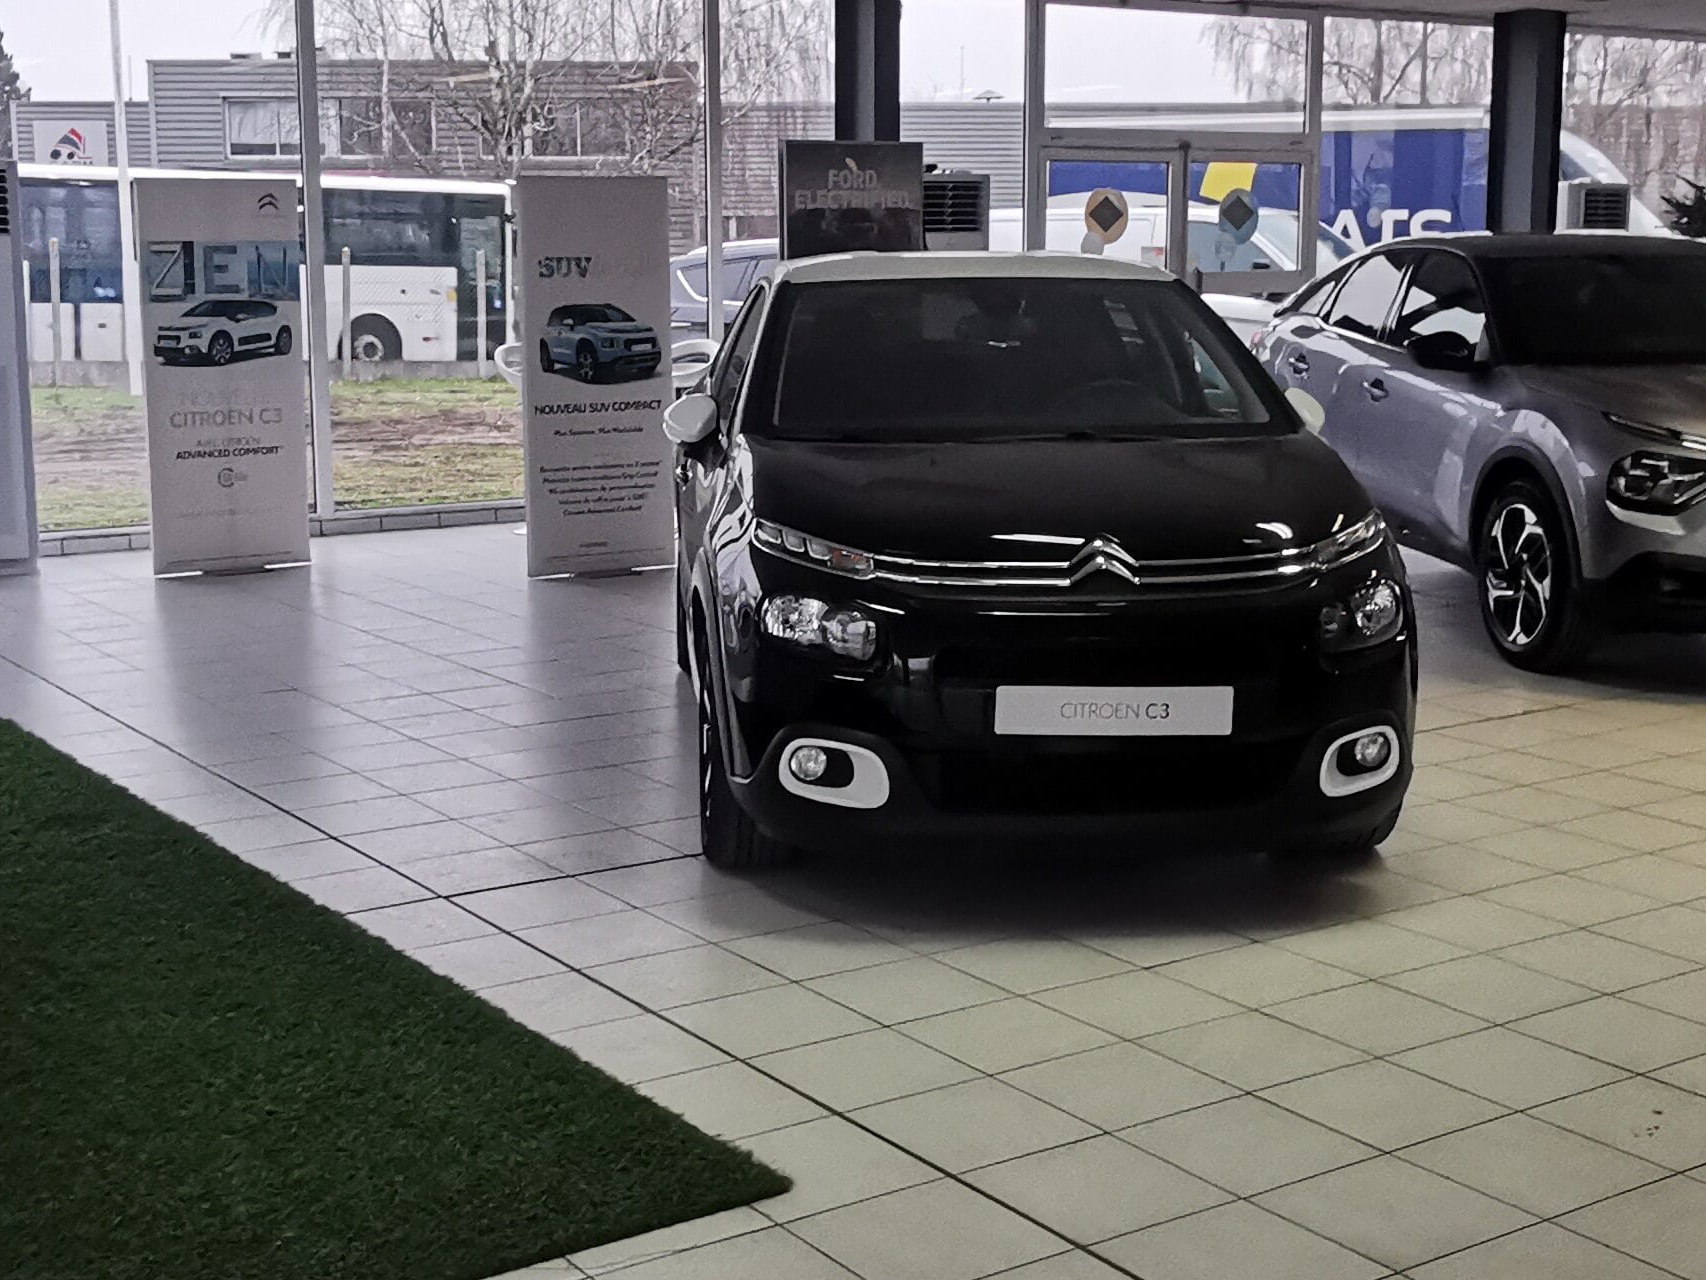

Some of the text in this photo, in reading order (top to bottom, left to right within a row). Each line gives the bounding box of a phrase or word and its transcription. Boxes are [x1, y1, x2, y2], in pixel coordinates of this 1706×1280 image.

[828, 169, 878, 190] FORD
[148, 241, 291, 302] ZEN
[538, 256, 592, 279] SUV
[259, 407, 283, 425] C3
[534, 400, 662, 416] NOUVEAU SUV COMPACT
[175, 447, 231, 460] ADVANCED
[1145, 702, 1170, 720] C3
